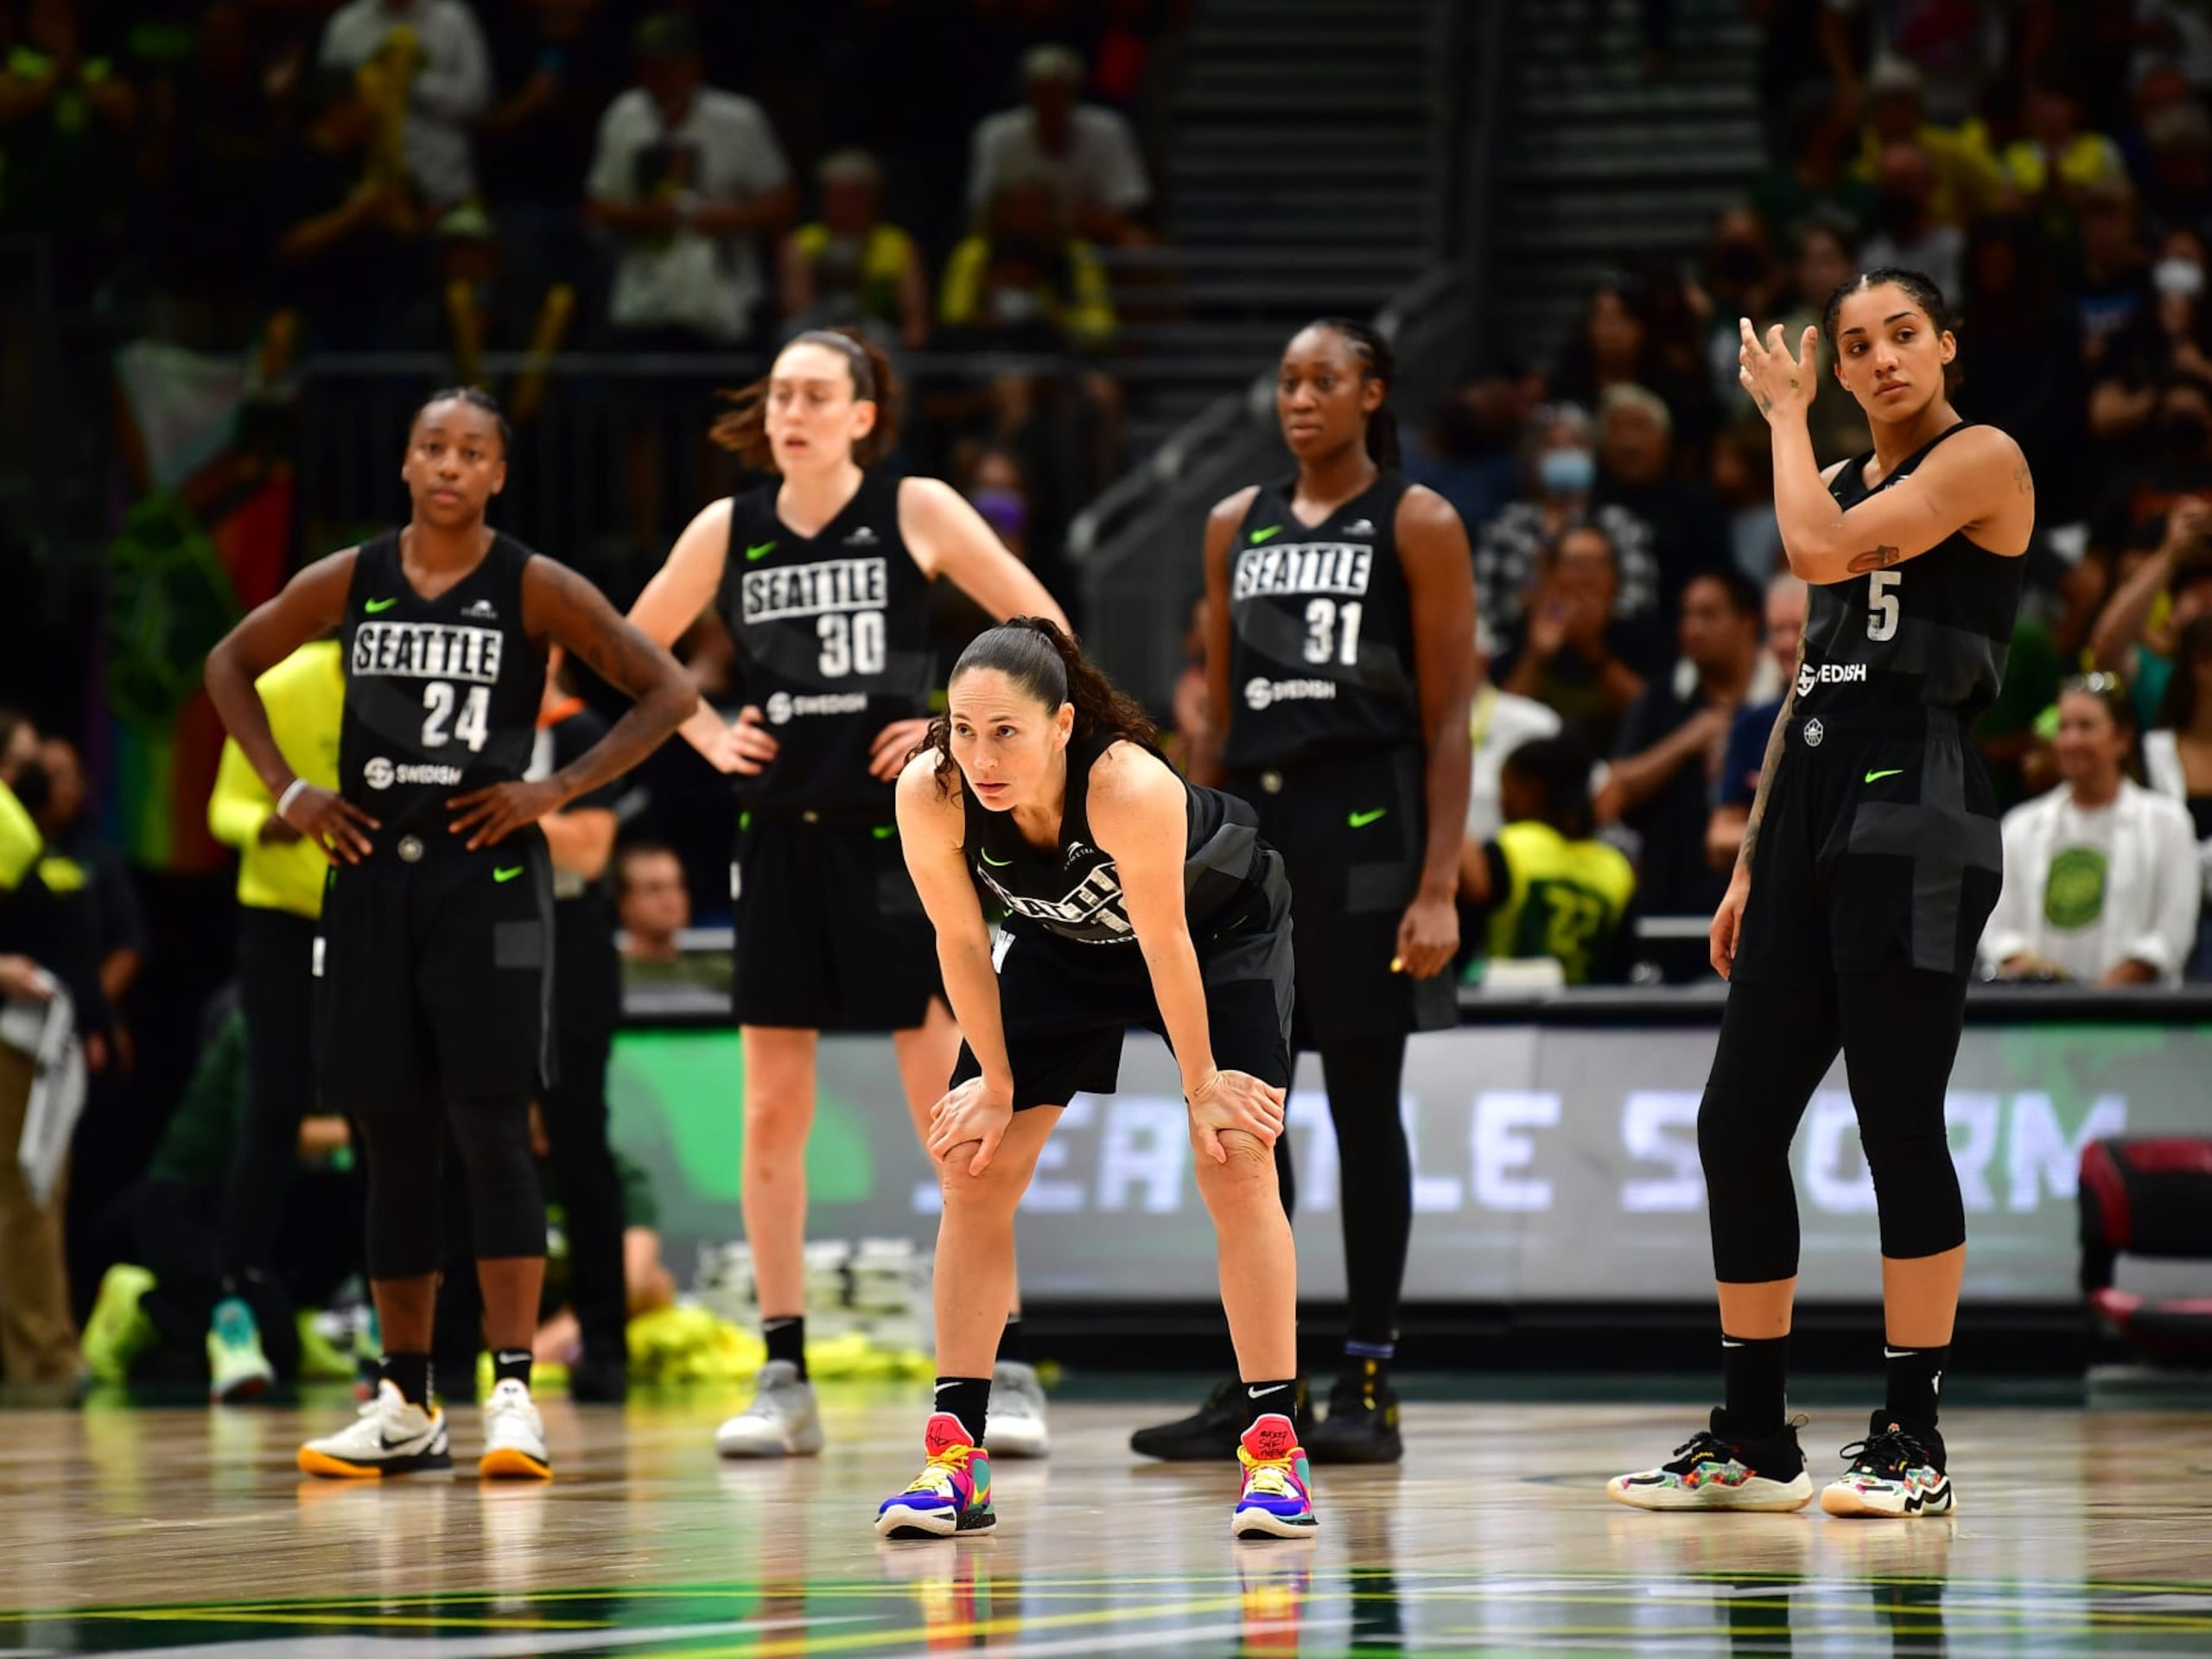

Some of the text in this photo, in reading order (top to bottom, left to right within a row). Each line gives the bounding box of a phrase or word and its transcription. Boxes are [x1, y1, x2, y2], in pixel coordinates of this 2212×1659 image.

[748, 563, 882, 615] SEATTLE
[1240, 547, 1368, 595] SEATTLE
[1302, 596, 1363, 665] 31
[1865, 570, 1903, 642] 5
[355, 624, 498, 677] SEATTLE
[816, 611, 887, 679] 30
[420, 680, 492, 753] 24
[394, 763, 463, 786] SWEDISH
[1621, 1089, 2129, 1213] SORM
